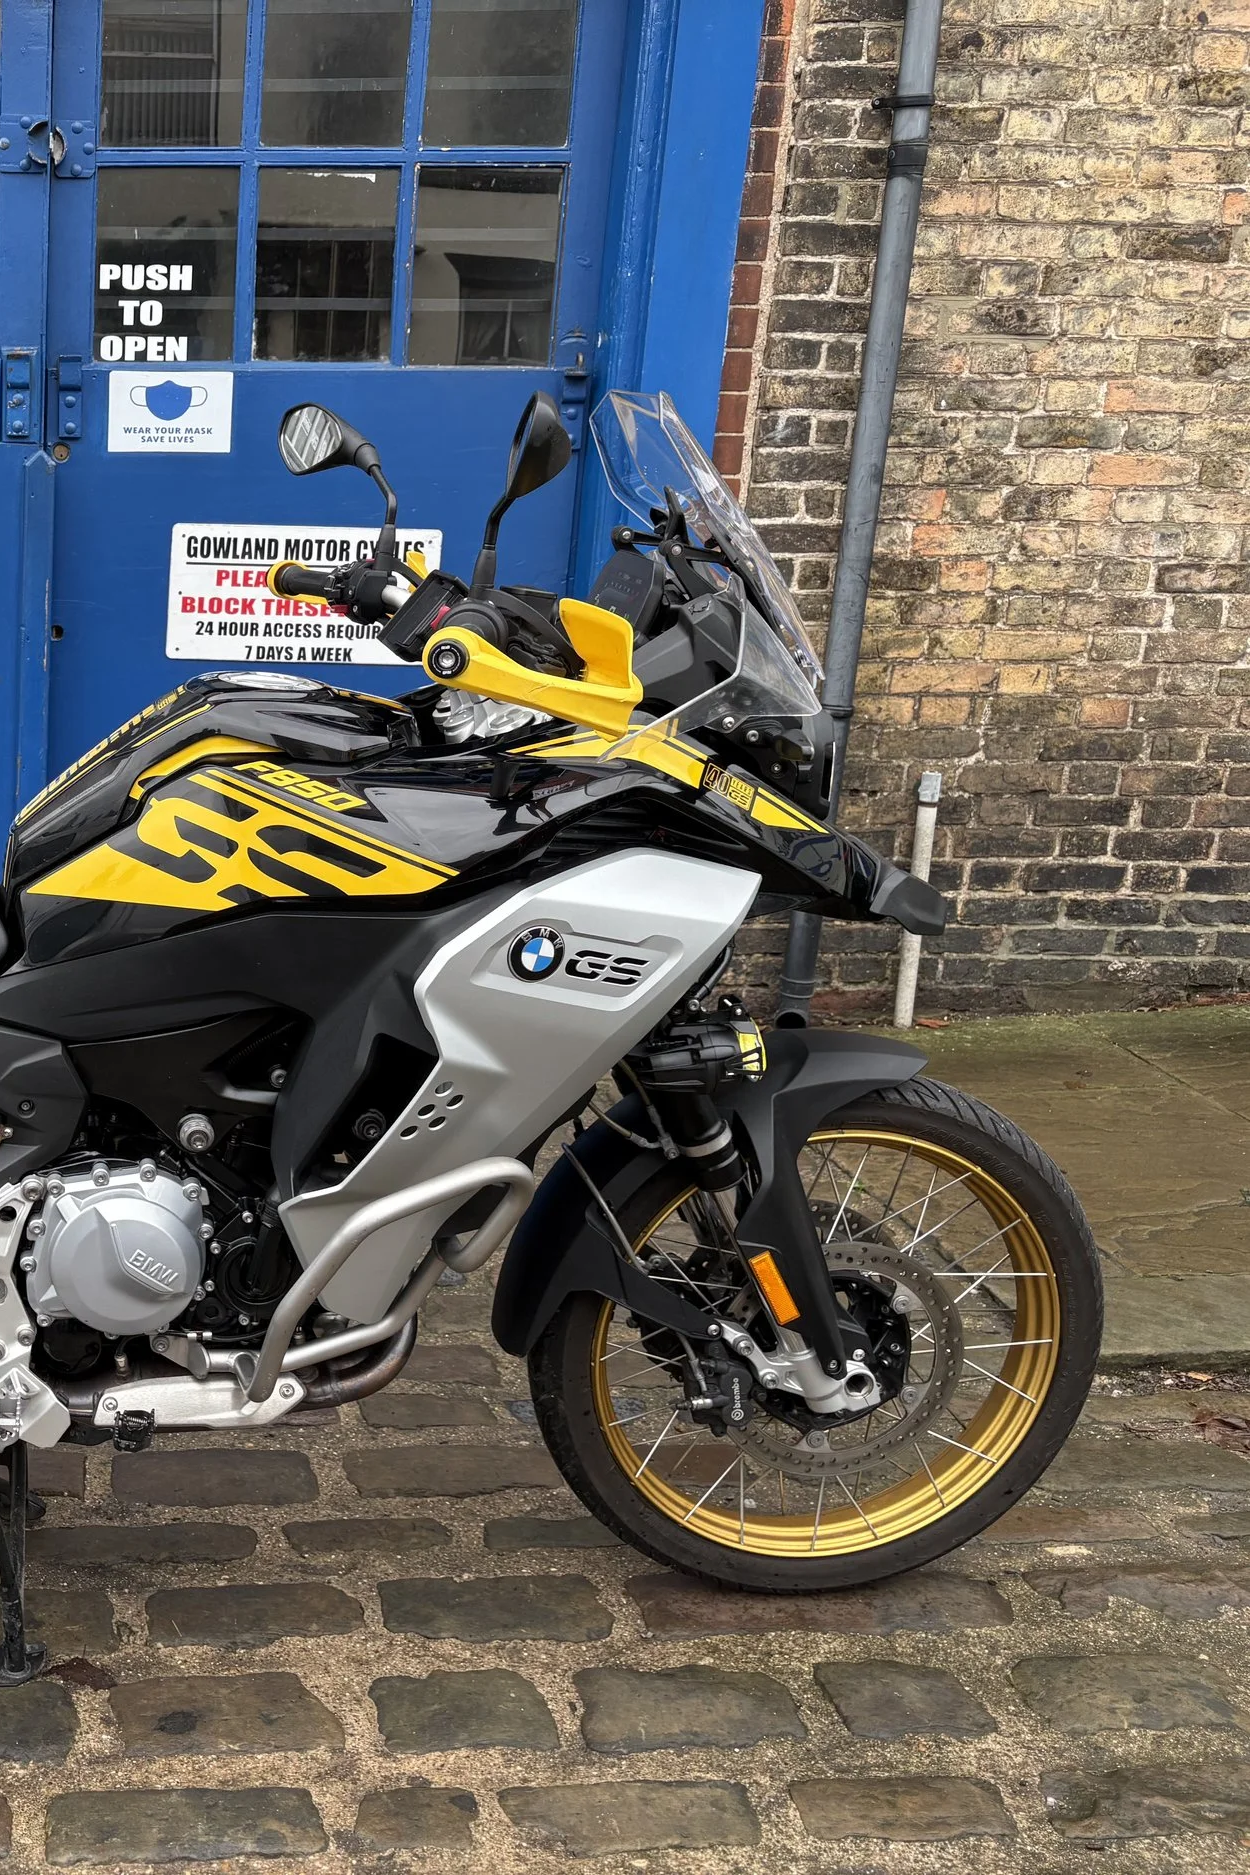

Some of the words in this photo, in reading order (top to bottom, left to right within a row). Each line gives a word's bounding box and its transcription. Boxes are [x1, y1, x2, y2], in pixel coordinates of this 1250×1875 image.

[99, 263, 193, 291] PUSH
[118, 299, 163, 326] TO
[100, 335, 188, 362] OPEN
[123, 426, 151, 435] WEAR
[154, 426, 181, 435] YOUR
[184, 427, 213, 435] MASK
[141, 435, 165, 443] SAVE
[168, 435, 195, 443] LIVES
[187, 535, 278, 560] GOWLAND
[285, 538, 350, 562] MOTOR
[356, 539, 425, 562] CYLES
[181, 596, 255, 615] BLOCK
[262, 598, 331, 618] THESE
[195, 621, 213, 636] 24
[218, 621, 259, 637] HOUR
[263, 623, 322, 639] ACCESS
[245, 645, 254, 660] 7
[256, 646, 293, 661] DAYS
[297, 647, 309, 661] A
[310, 647, 352, 662] WEEK
[232, 760, 368, 813] F850
[705, 767, 731, 794] 40
[729, 789, 750, 805] GS
[521, 927, 565, 950] BMW
[564, 949, 650, 987] GS
[128, 1248, 179, 1285] BMW
[732, 1377, 741, 1409] brembo
